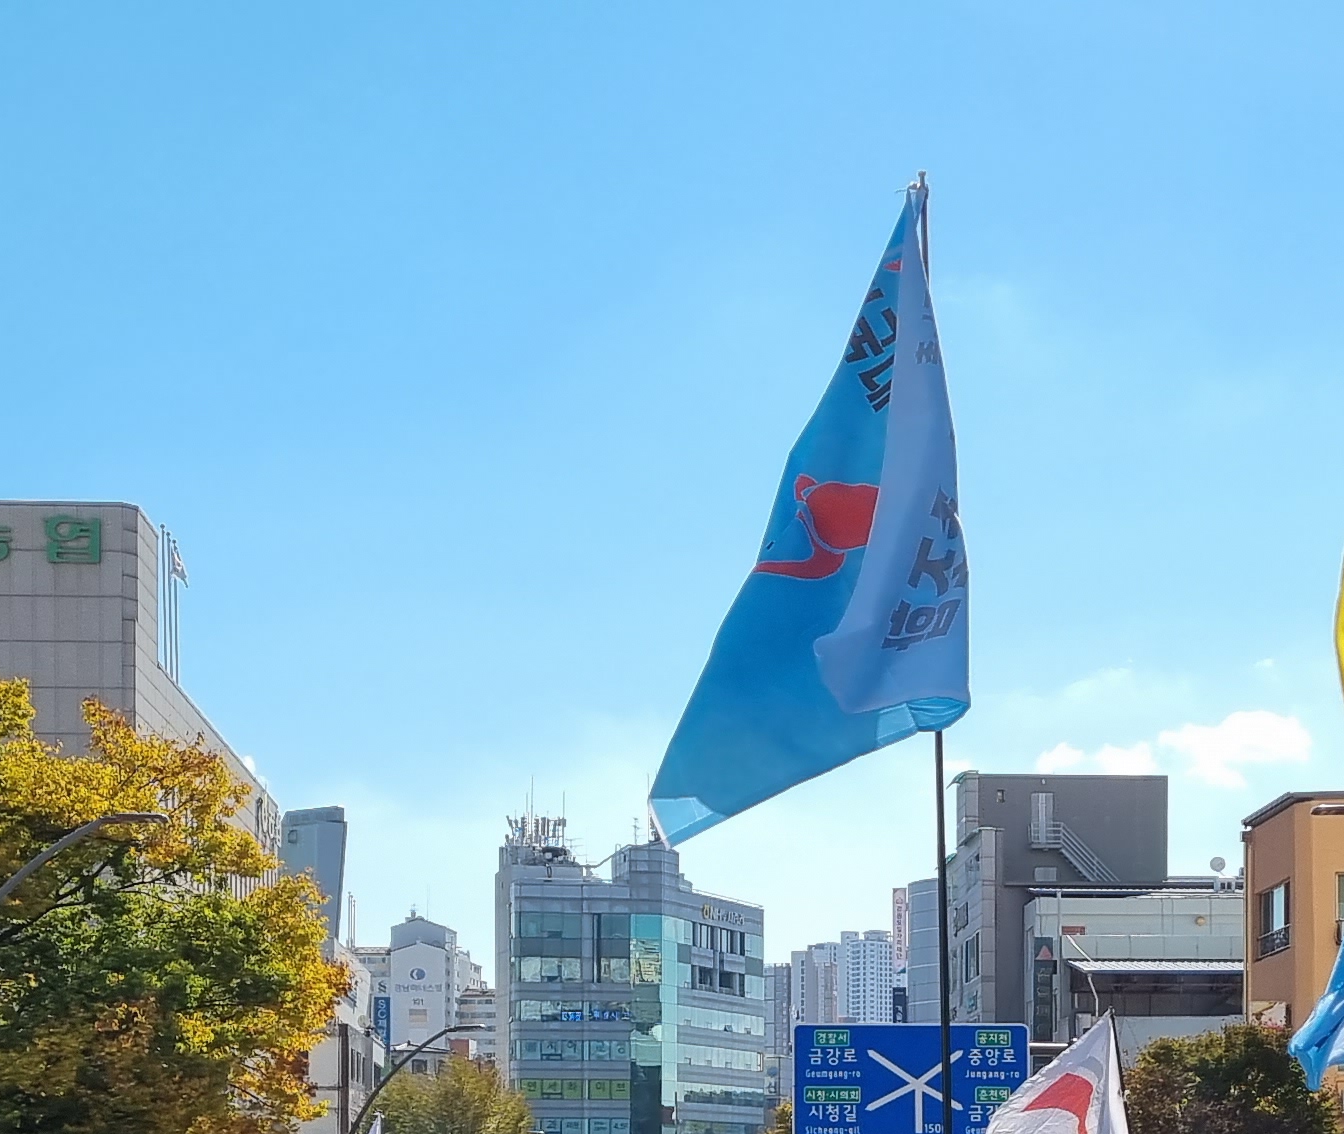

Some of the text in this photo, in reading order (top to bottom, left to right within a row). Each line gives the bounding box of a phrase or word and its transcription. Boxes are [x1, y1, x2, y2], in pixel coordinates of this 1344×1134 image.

[817, 1032, 847, 1044] 경찰서
[978, 1032, 1008, 1045] 공지천
[808, 1048, 857, 1066] 금강로
[968, 1048, 1017, 1066] 중앙로
[805, 1068, 861, 1080] Geumgang-ro
[965, 1069, 1020, 1080] Jungang-ro
[978, 1089, 1008, 1101] 춘천역
[808, 1104, 857, 1122] 시청길
[924, 1123, 944, 1134] 150
